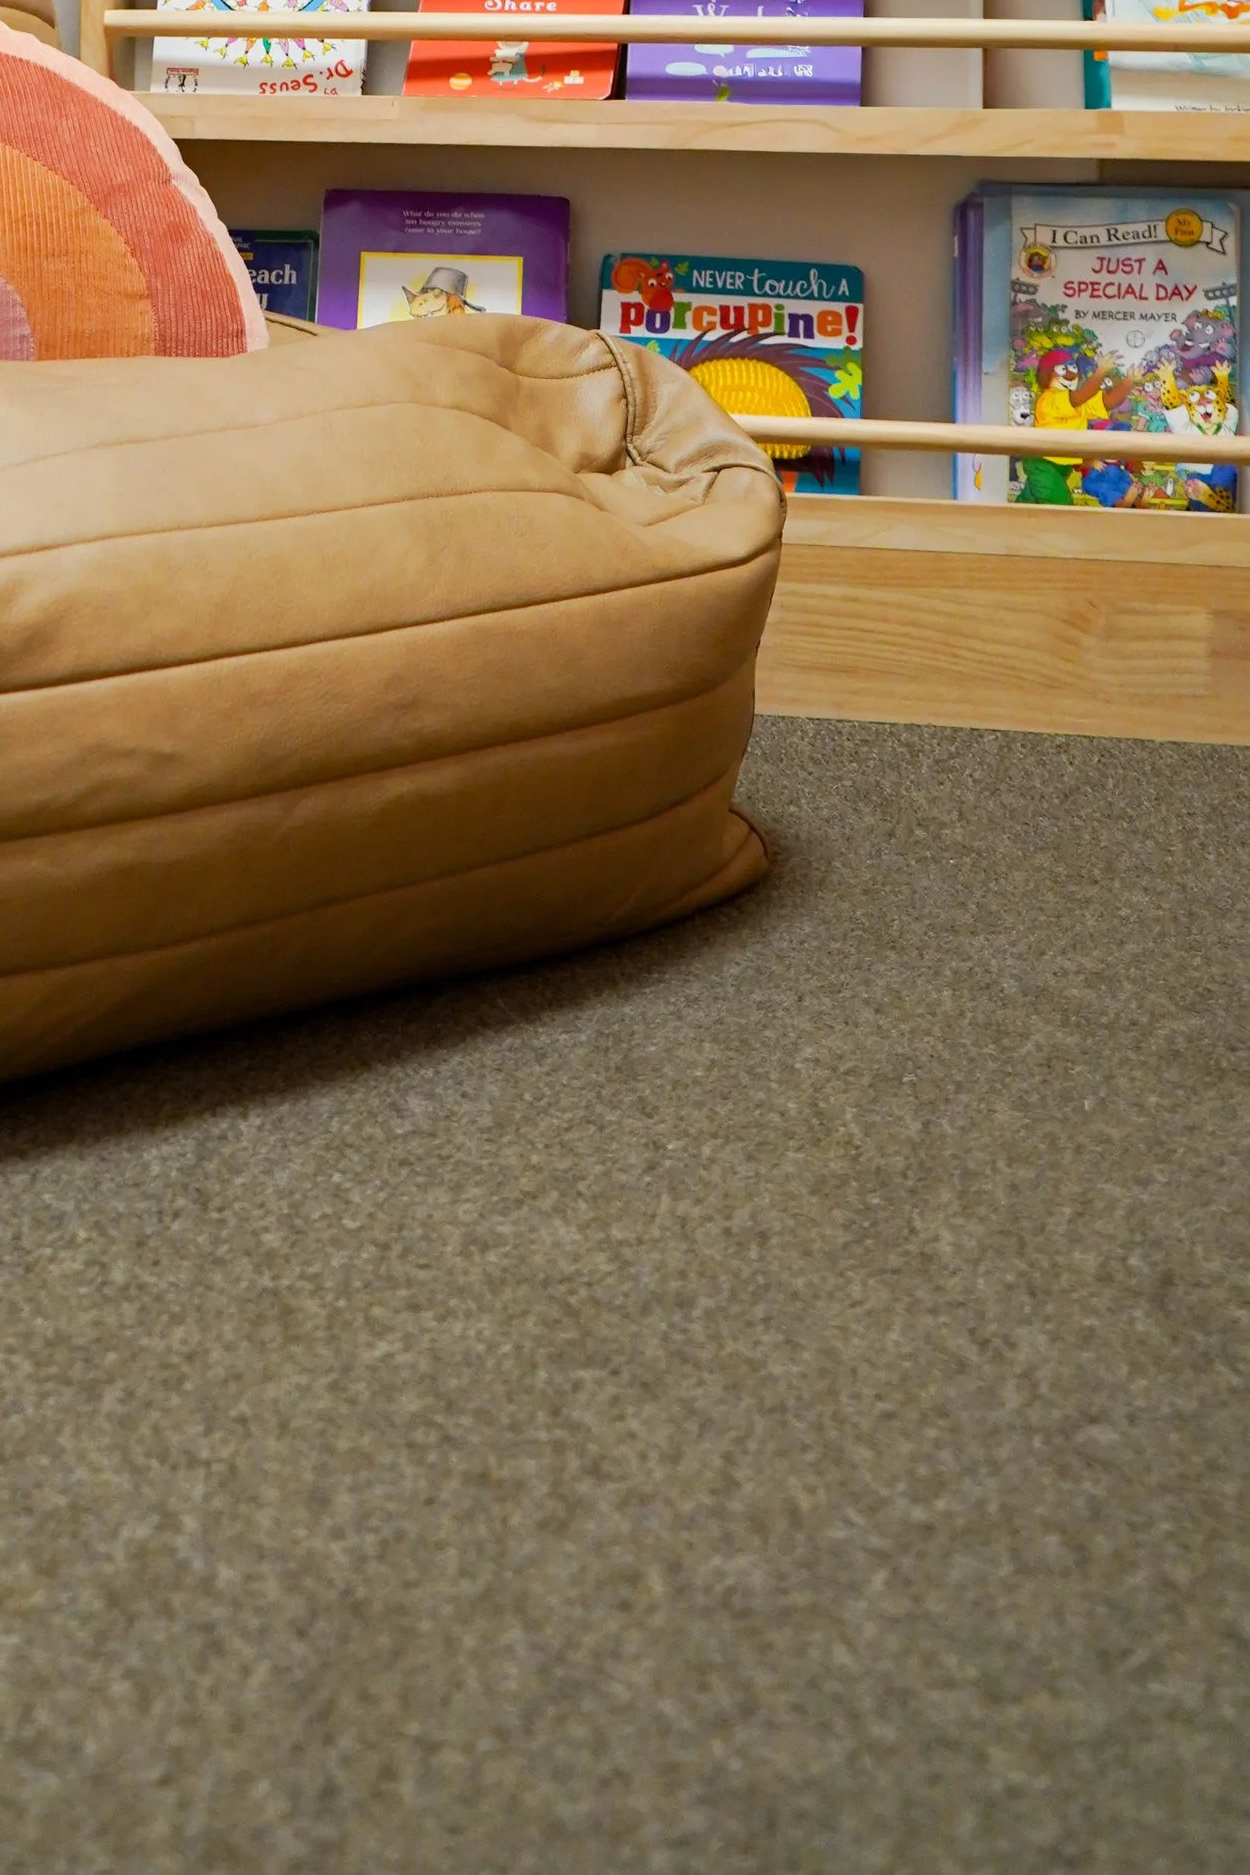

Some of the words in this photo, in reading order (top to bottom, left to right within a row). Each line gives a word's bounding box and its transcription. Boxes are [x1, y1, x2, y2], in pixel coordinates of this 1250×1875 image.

[319, 59, 354, 81] Dr.
[259, 73, 318, 95] Seuss
[1050, 229, 1057, 244] I
[1063, 229, 1100, 245] Can
[1106, 224, 1159, 242] Read!
[1091, 256, 1147, 275] JUST
[1152, 258, 1168, 276] A
[692, 268, 746, 291] NEVER
[746, 267, 835, 300] touch
[838, 278, 850, 296] A
[1062, 280, 1149, 301] SPECIAL
[1155, 283, 1198, 302] DAY
[618, 300, 860, 346] porcupine!
[1074, 309, 1089, 320] BY
[1092, 310, 1136, 322] MERCER
[1139, 312, 1178, 322] MAYER
